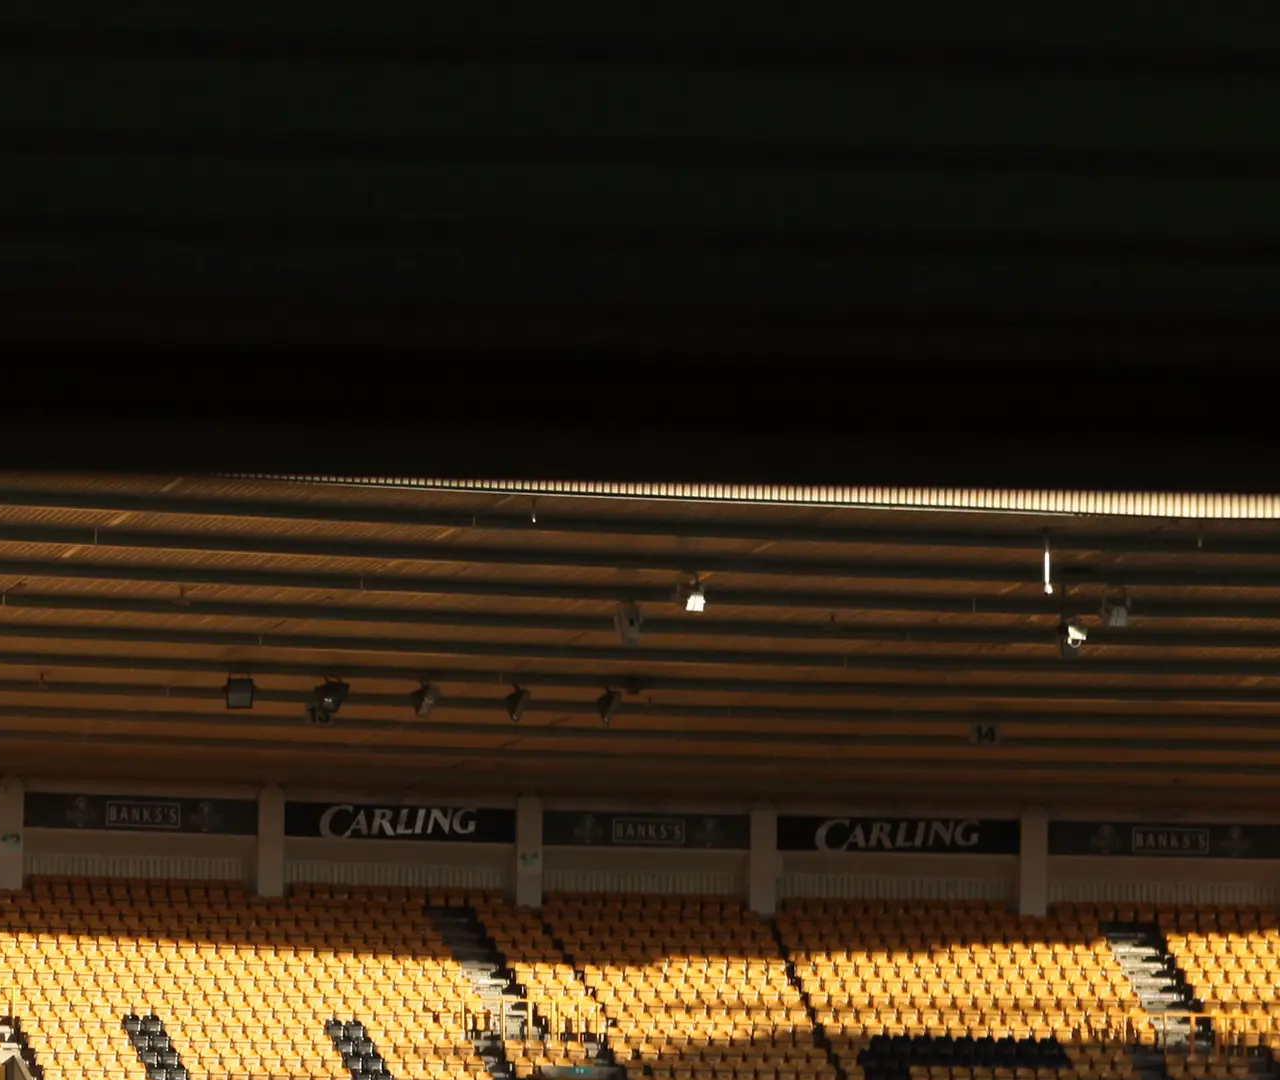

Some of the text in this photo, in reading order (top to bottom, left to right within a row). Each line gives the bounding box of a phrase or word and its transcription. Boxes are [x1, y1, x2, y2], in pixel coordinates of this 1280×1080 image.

[976, 725, 996, 744] 14
[109, 804, 178, 823] BANKS'S
[320, 805, 477, 839] CARLING
[615, 822, 682, 839] BANKS'S
[815, 818, 980, 851] CARLING
[1136, 833, 1205, 850] BANKS'S
